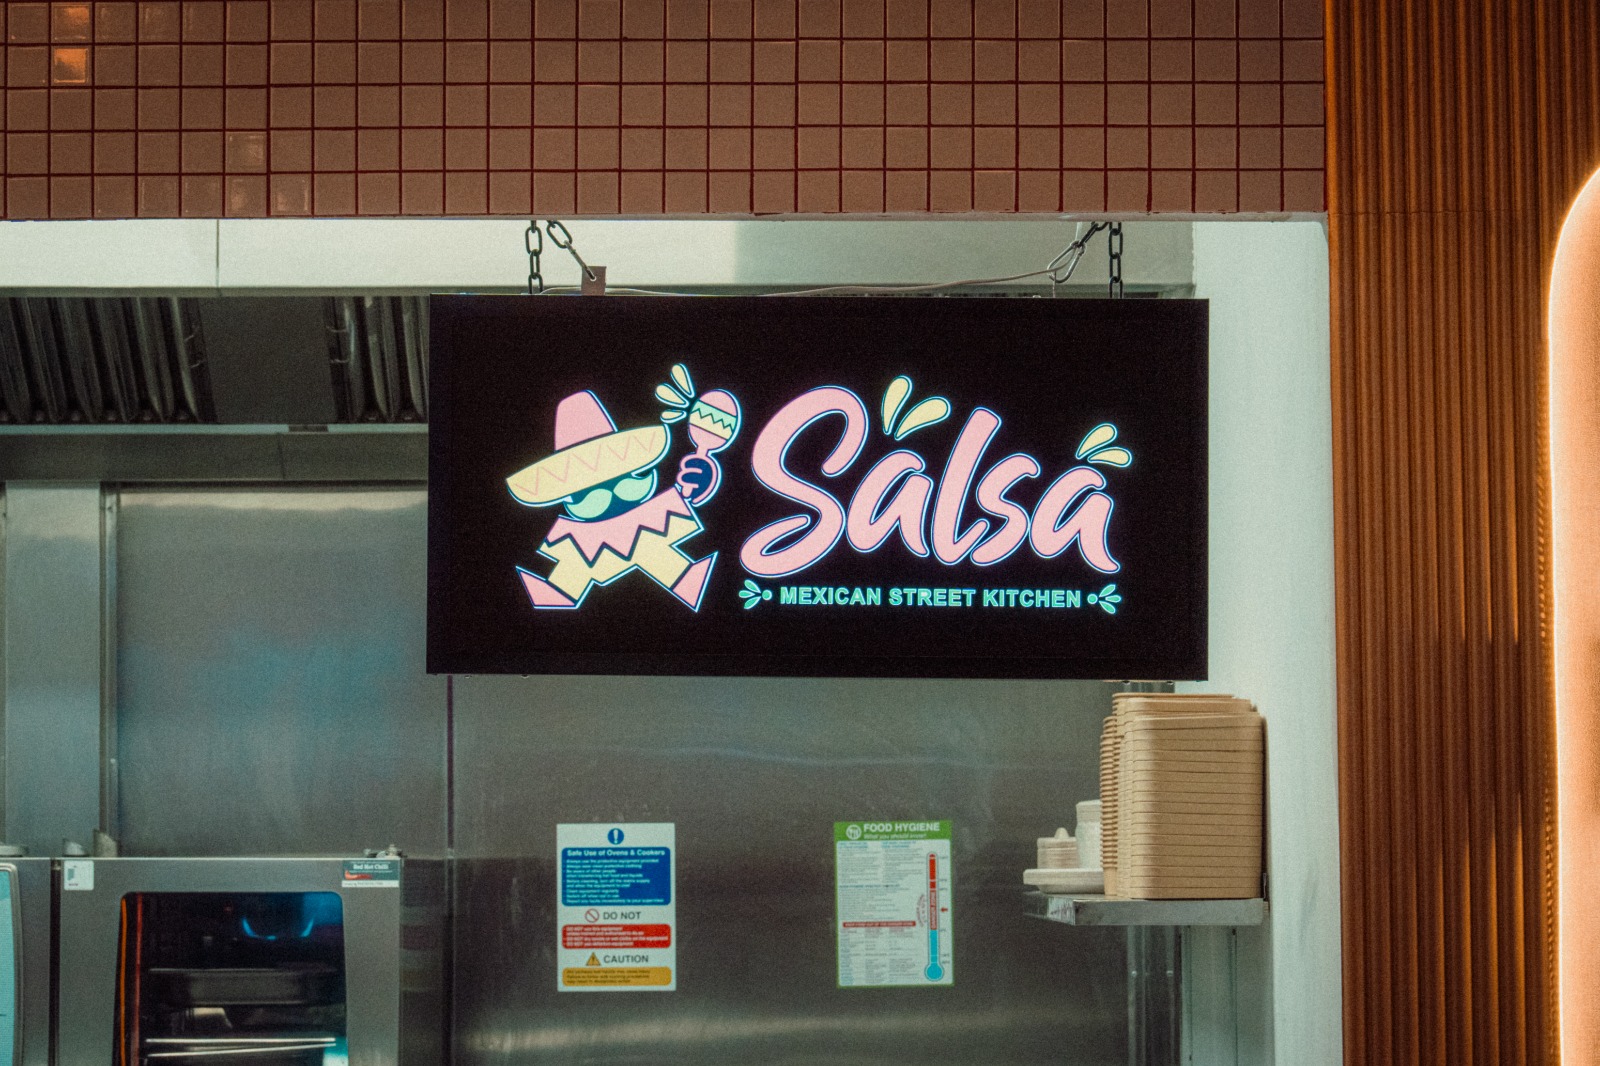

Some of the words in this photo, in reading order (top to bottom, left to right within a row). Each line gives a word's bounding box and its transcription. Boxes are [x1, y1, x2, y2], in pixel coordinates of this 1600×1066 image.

[739, 385, 1120, 578] Salsa
[780, 587, 881, 605] MEXICAN
[888, 588, 976, 607] STREET
[983, 589, 1081, 608] KITCHEN
[864, 823, 893, 832] FOOD
[895, 822, 940, 832] HYGIENE
[567, 849, 582, 857] Safe
[603, 911, 618, 920] DO
[620, 911, 641, 920] NOT
[603, 954, 649, 963] CAUTION
